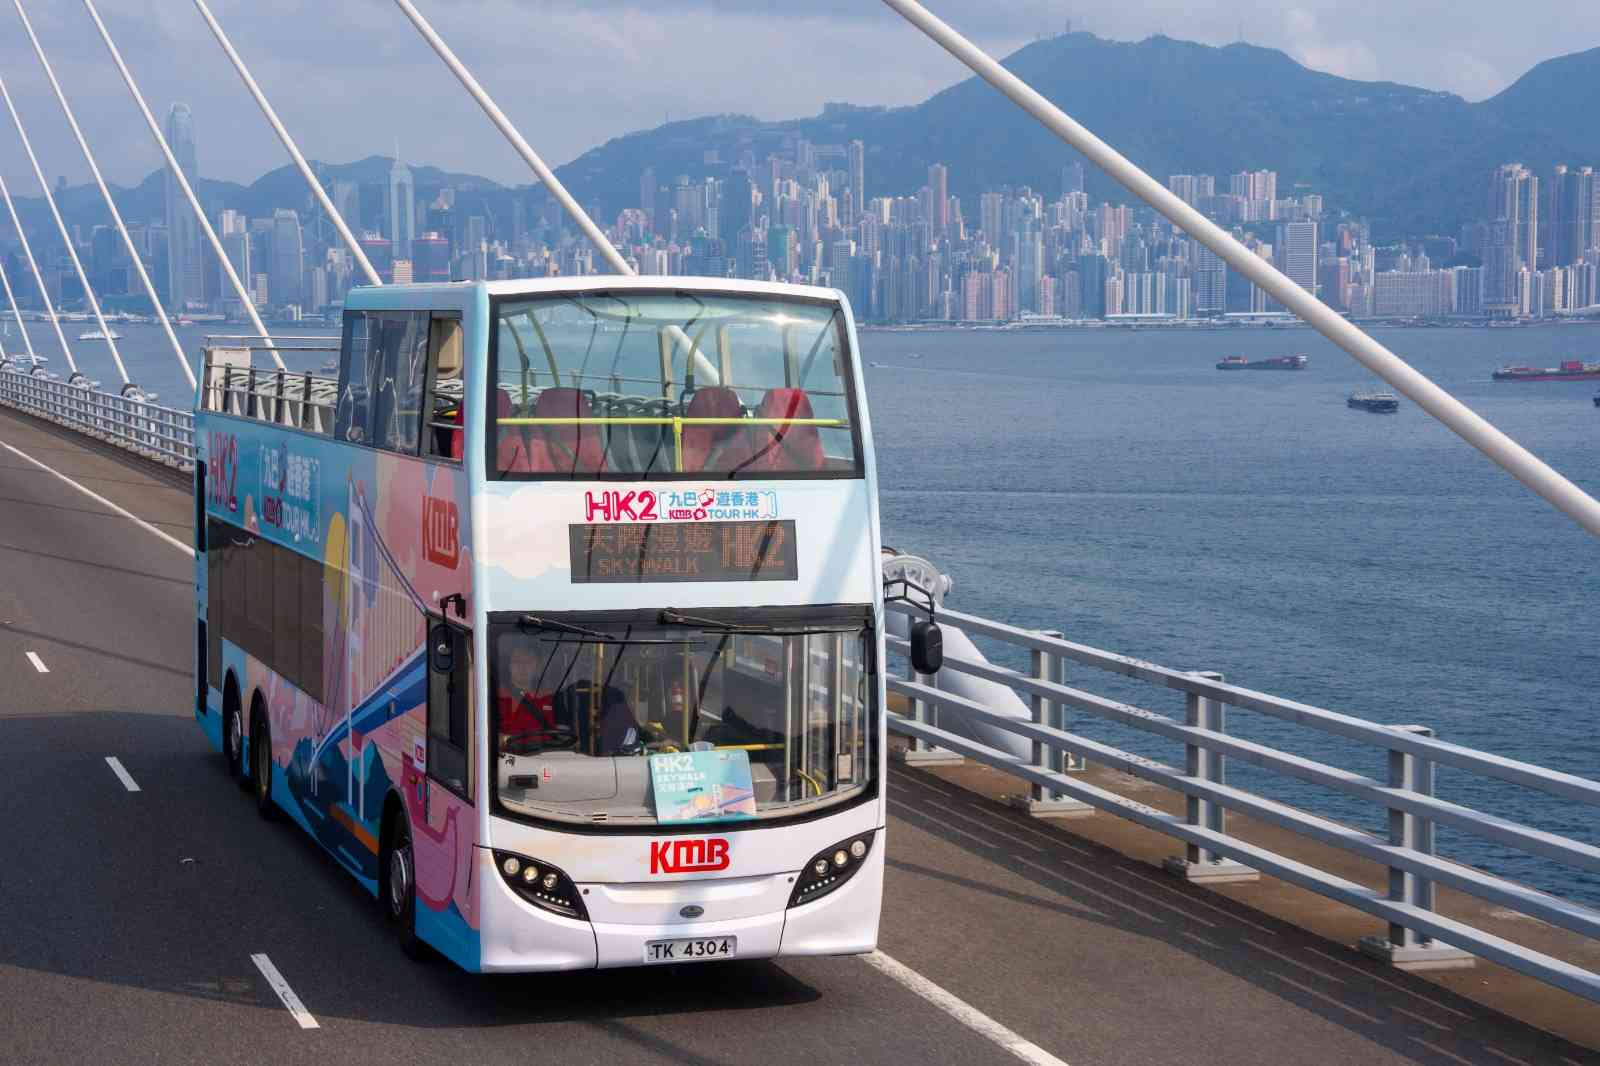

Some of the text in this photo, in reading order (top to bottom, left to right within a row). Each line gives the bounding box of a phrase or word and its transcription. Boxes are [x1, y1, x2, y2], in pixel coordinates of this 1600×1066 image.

[208, 432, 238, 512] HK2
[584, 490, 658, 521] HK2
[669, 491, 759, 507] 九巴 遊香港
[669, 509, 759, 520] KMB TOUR HK
[423, 495, 459, 570] KMB
[721, 526, 785, 568] HK2
[599, 557, 698, 576] SKYWALK
[653, 754, 695, 772] HK2
[650, 838, 730, 874] KMB
[652, 940, 729, 959] TK 4304
